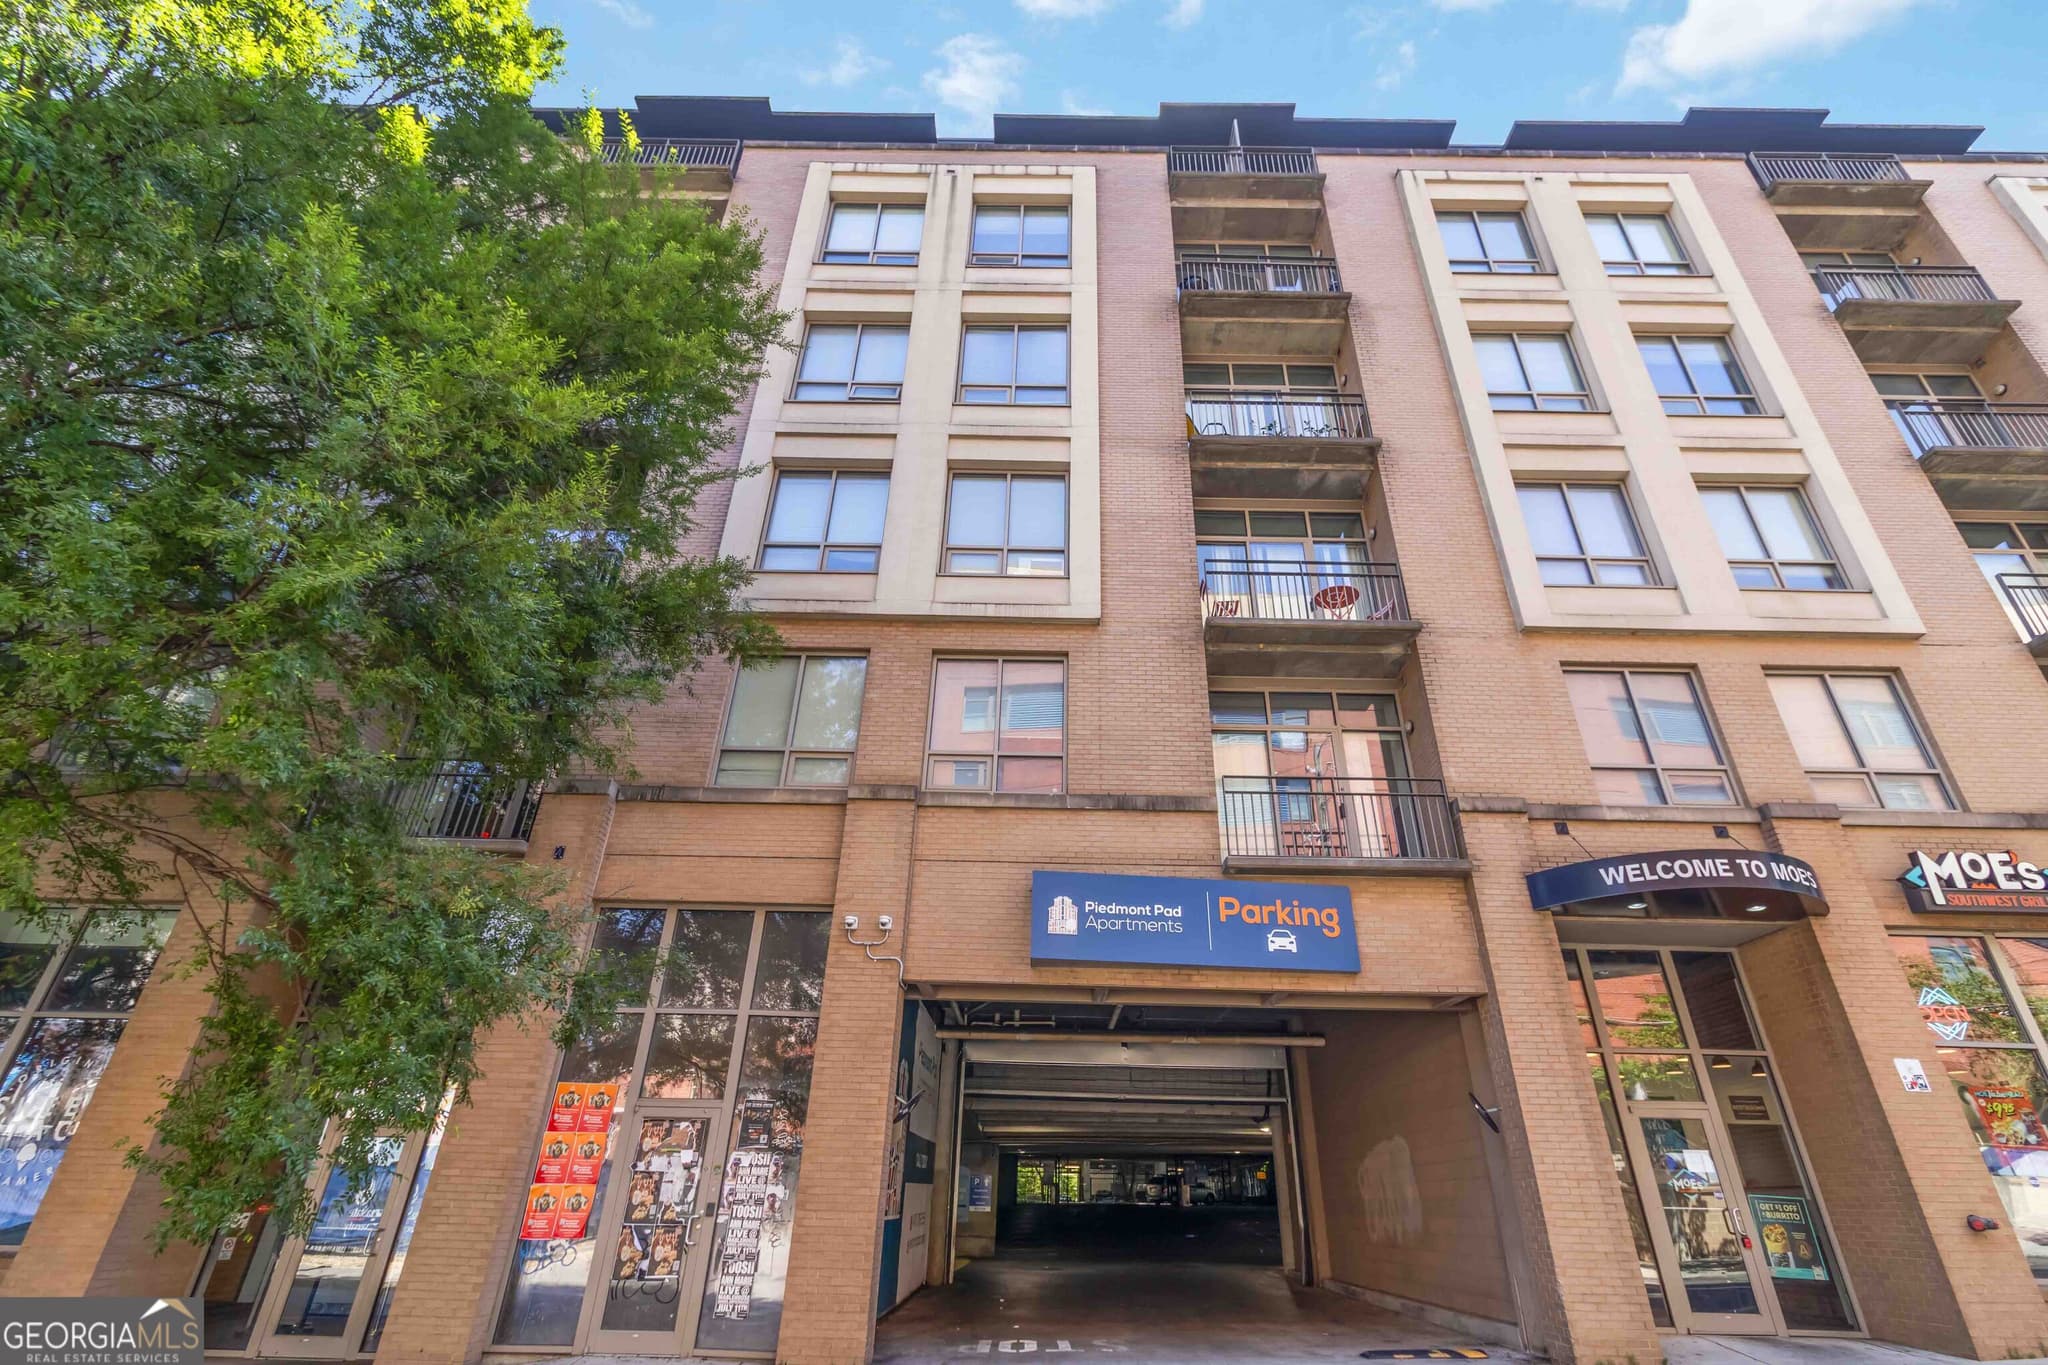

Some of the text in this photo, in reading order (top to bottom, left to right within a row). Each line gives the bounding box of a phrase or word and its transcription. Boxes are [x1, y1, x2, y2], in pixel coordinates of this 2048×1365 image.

[1599, 858, 1734, 886] WELCOME
[1736, 859, 1768, 879] TO
[1947, 894, 2019, 907] SOUTHWEST
[1085, 901, 1182, 917] Piedmont Pad
[1218, 896, 1341, 938] Parking
[1084, 915, 1183, 933] Apartments
[737, 1175, 757, 1184] LIVE
[732, 1205, 763, 1218] TOOSII
[1765, 1211, 1801, 1220] BURRITO
[728, 1229, 748, 1238] LIVE
[726, 1246, 742, 1254] JULY
[723, 1261, 755, 1274] TOOSII
[719, 1286, 740, 1295] LIVE
[717, 1304, 733, 1312] JULY
